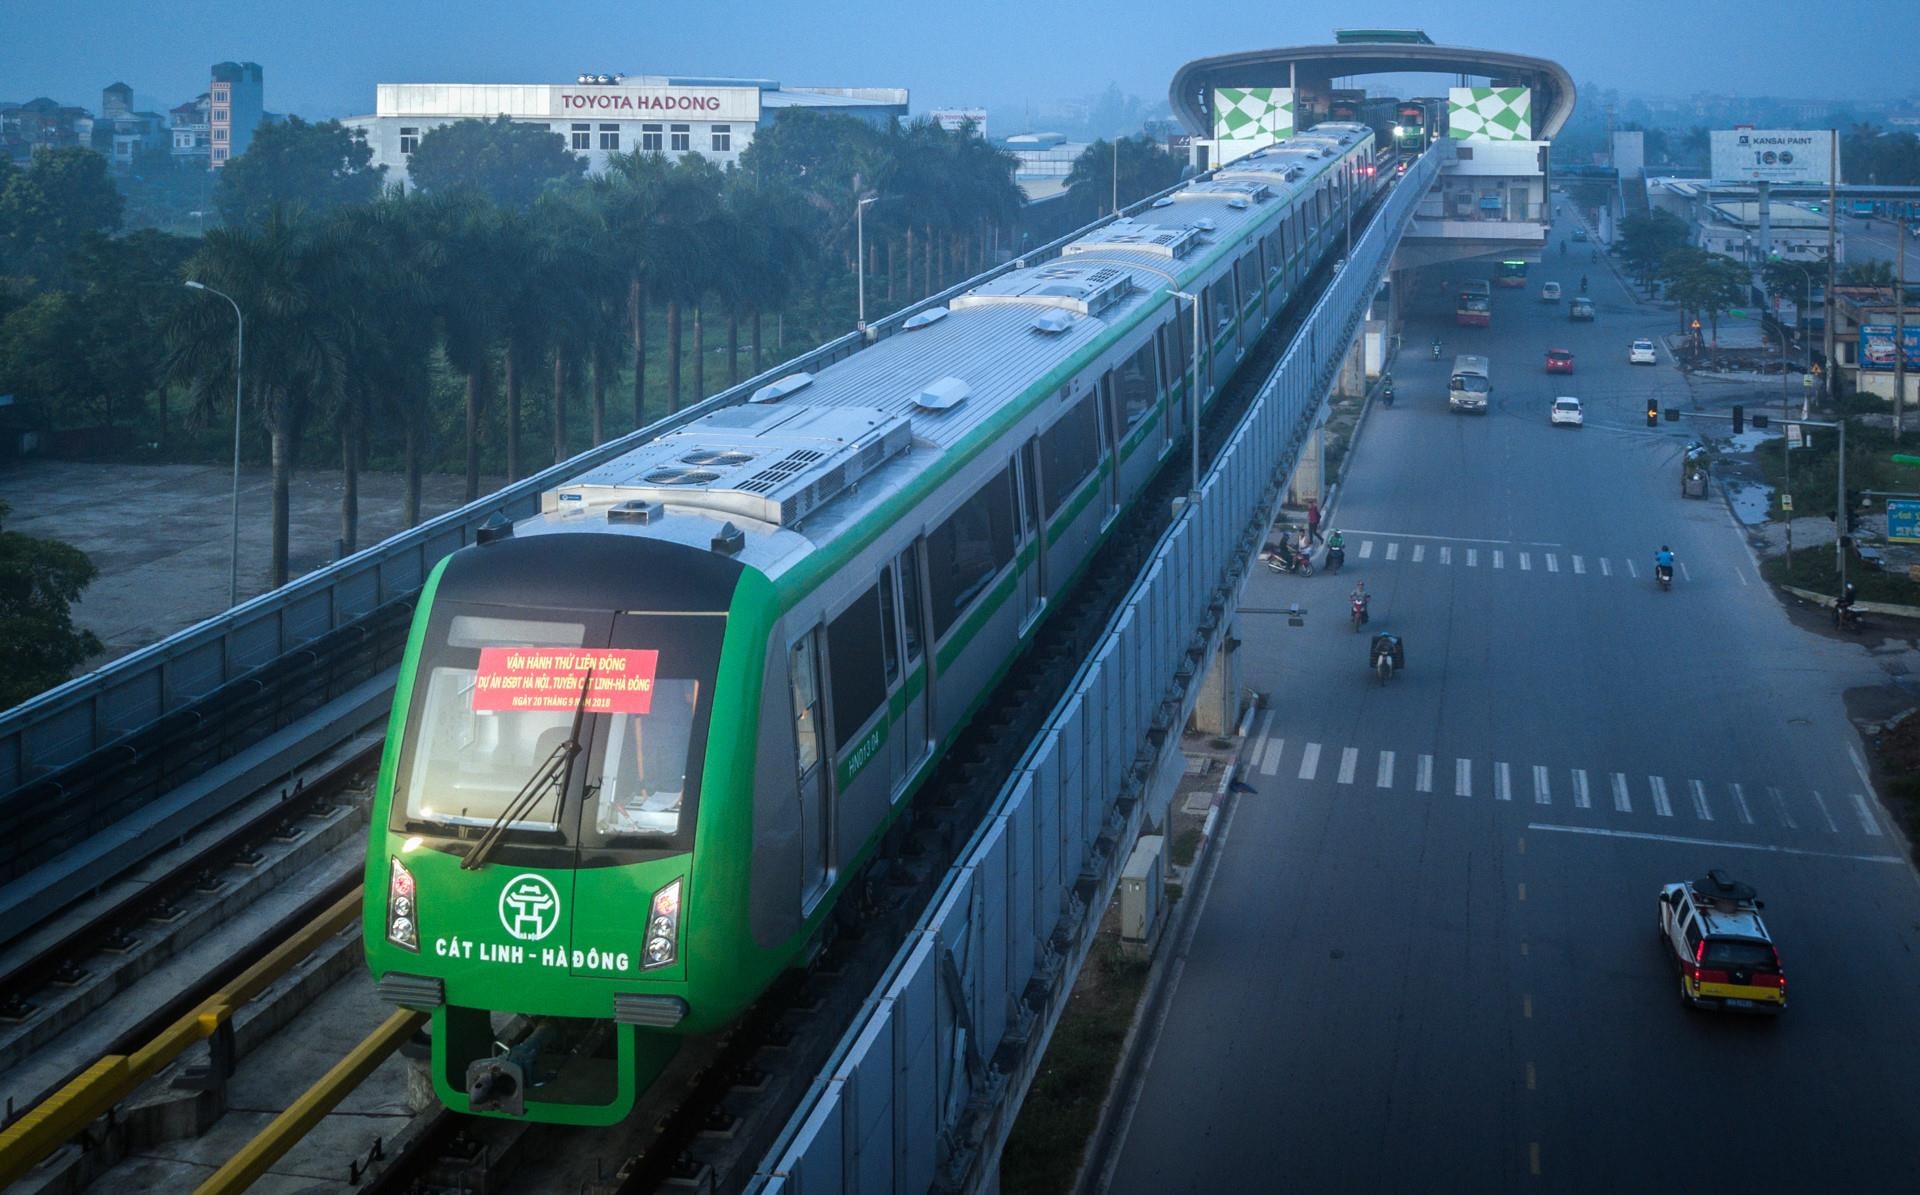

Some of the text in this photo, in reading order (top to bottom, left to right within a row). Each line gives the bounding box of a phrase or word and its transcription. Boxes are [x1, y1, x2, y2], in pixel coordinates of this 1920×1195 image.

[562, 95, 720, 111] TOYOTA HADONG
[1753, 137, 1812, 145] KANSAI PAINT
[1754, 151, 1793, 165] 100
[507, 652, 525, 672] VẬN
[526, 652, 552, 669] HÀNH
[575, 652, 597, 670] LIÊN
[598, 653, 626, 674] ĐỘNG
[478, 673, 491, 692] DỰ
[490, 672, 502, 689] ÁN
[522, 673, 534, 689] HÀ
[578, 676, 594, 690] CT
[627, 674, 650, 691] ĐÔNG
[512, 694, 532, 706] NGÀY
[533, 697, 542, 706] 20
[543, 694, 568, 707] THÁNG
[568, 697, 574, 707] 9
[592, 697, 611, 708] 2018
[435, 936, 473, 959] CÁT
[479, 943, 524, 964] LINH
[542, 945, 568, 967] HÀ
[572, 947, 629, 971] ĐÔNG
